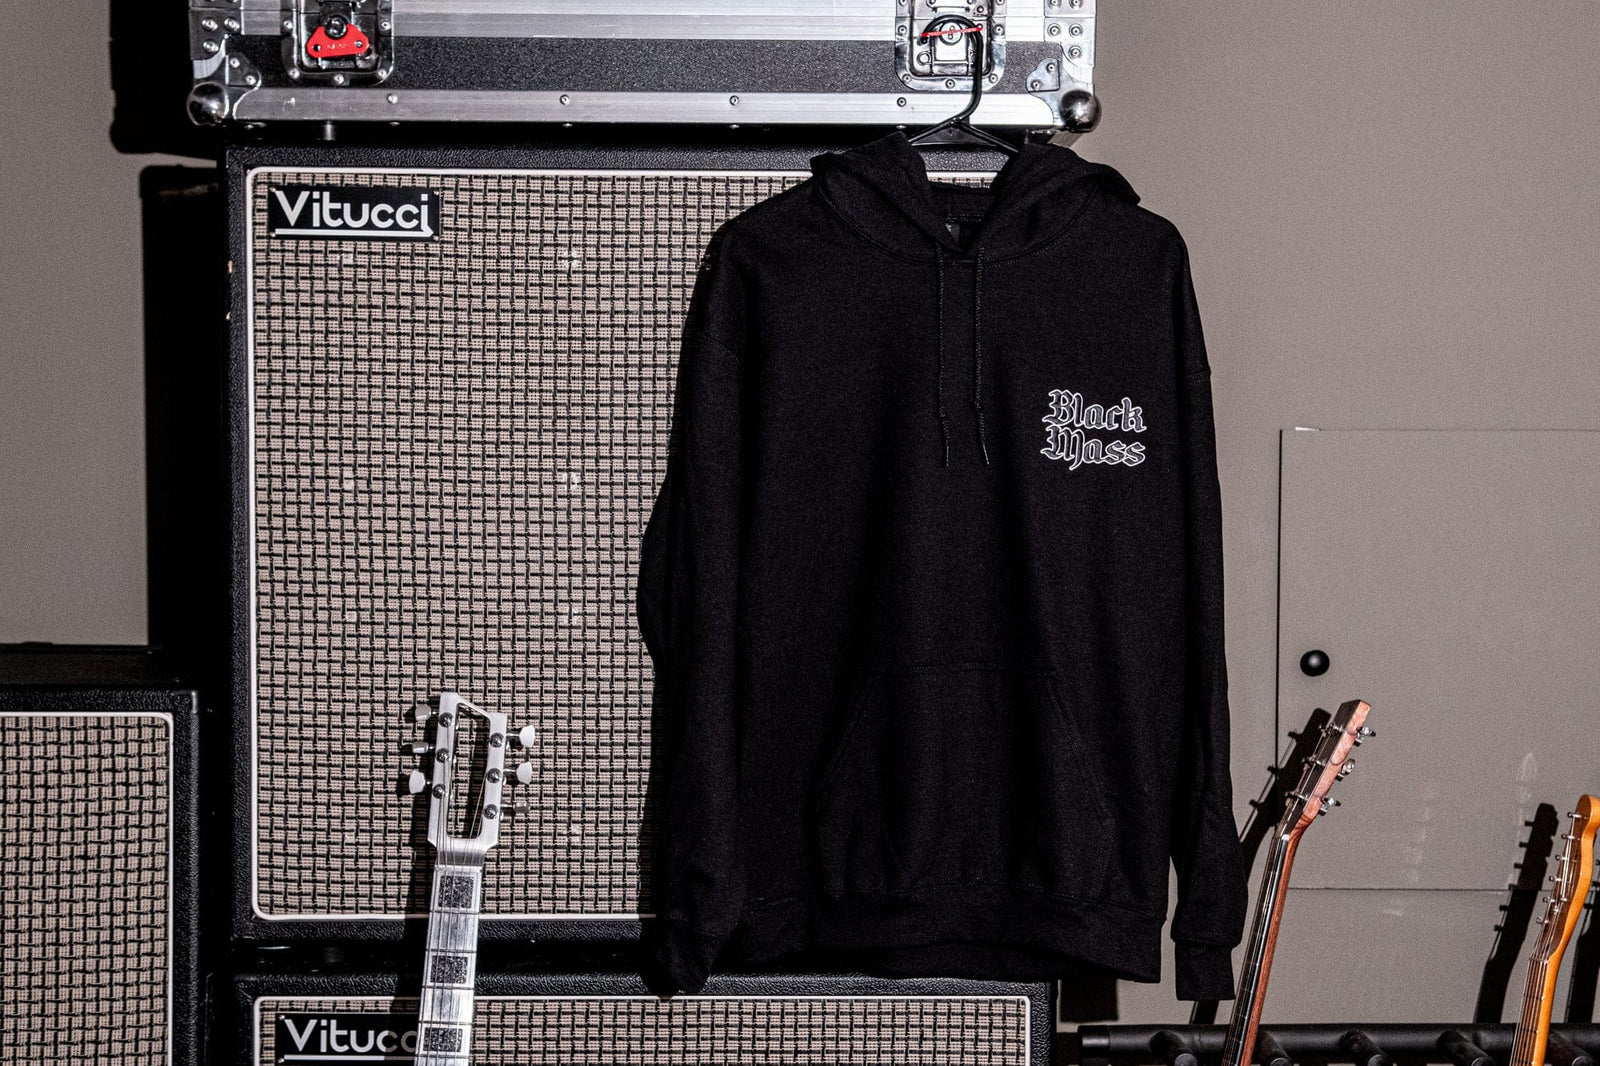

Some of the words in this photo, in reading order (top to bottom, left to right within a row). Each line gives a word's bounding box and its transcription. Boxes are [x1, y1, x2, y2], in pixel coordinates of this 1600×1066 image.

[275, 190, 433, 237] Vitucci
[1041, 389, 1147, 433] Black
[1040, 424, 1146, 471] Mass
[284, 1018, 418, 1053] Vitucc
